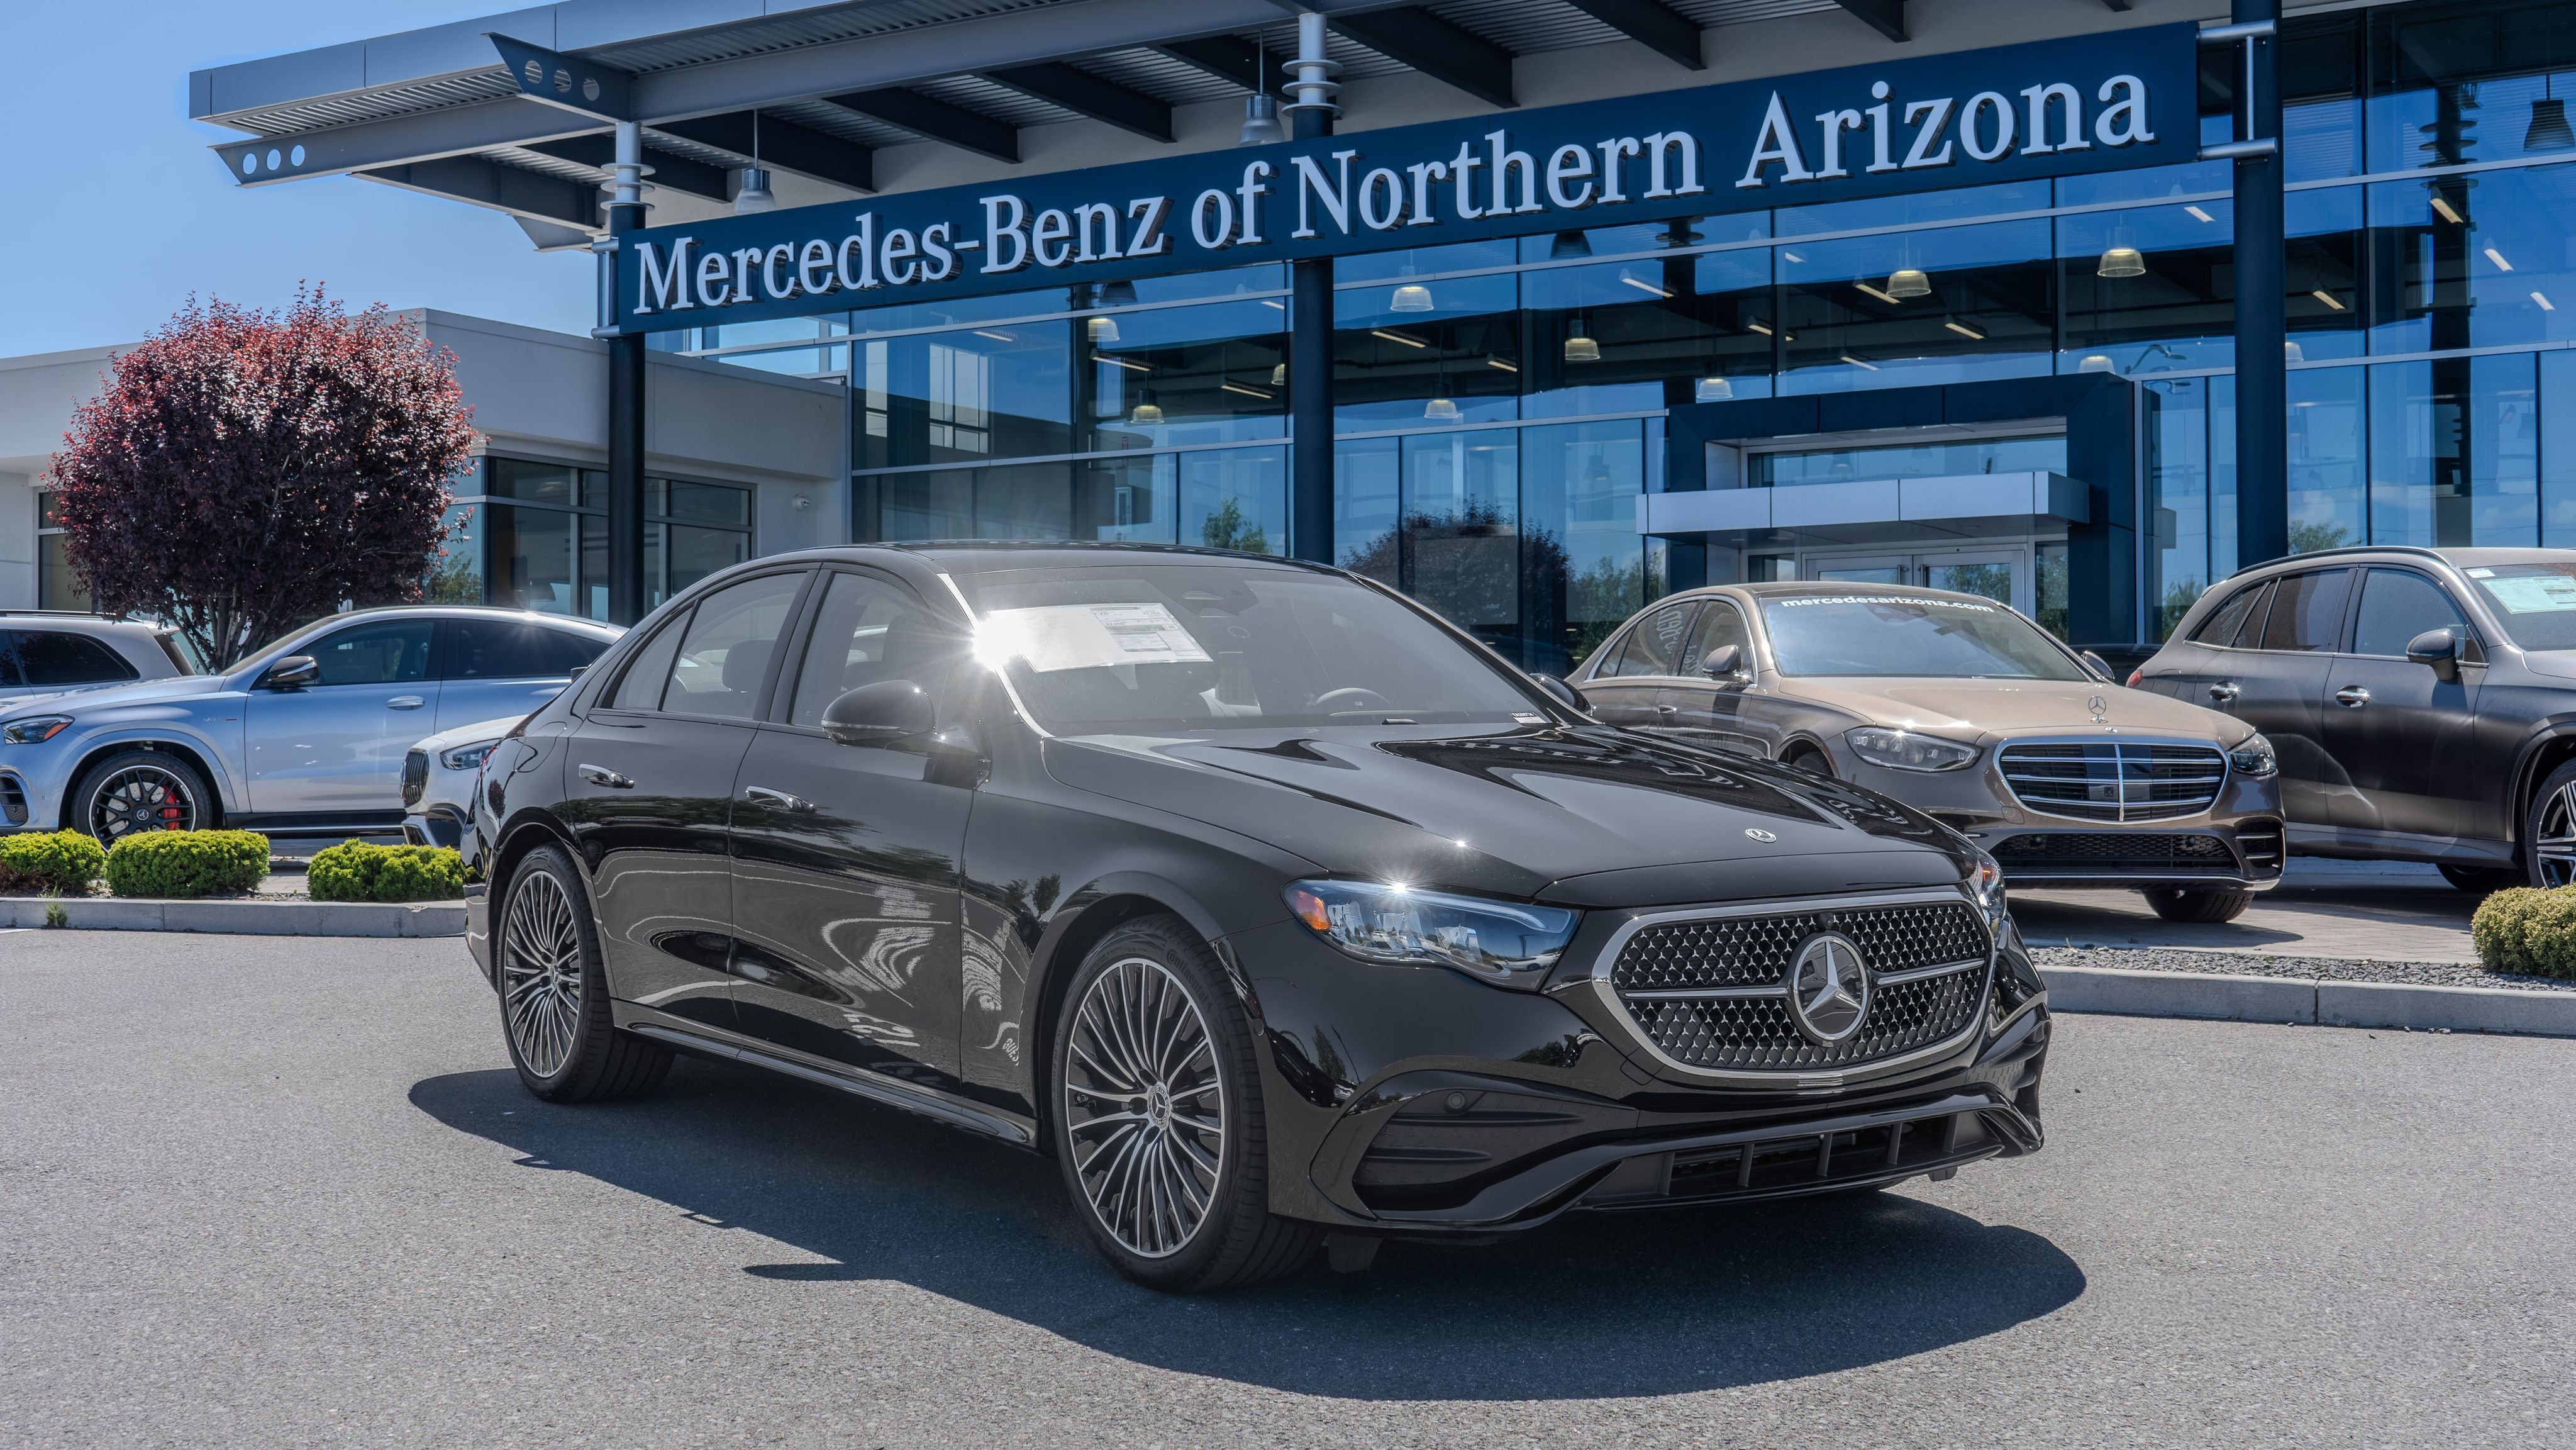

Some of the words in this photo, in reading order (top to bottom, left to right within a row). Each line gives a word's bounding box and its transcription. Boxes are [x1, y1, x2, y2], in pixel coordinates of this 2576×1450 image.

[633, 195, 1167, 315] Mercedes-Benz
[1191, 160, 1274, 248] of
[1291, 129, 1705, 238] Northern
[1735, 75, 2155, 187] Arizona
[1780, 596, 1995, 613] mercedesarizona.com
[1166, 949, 1209, 1004] Continental
